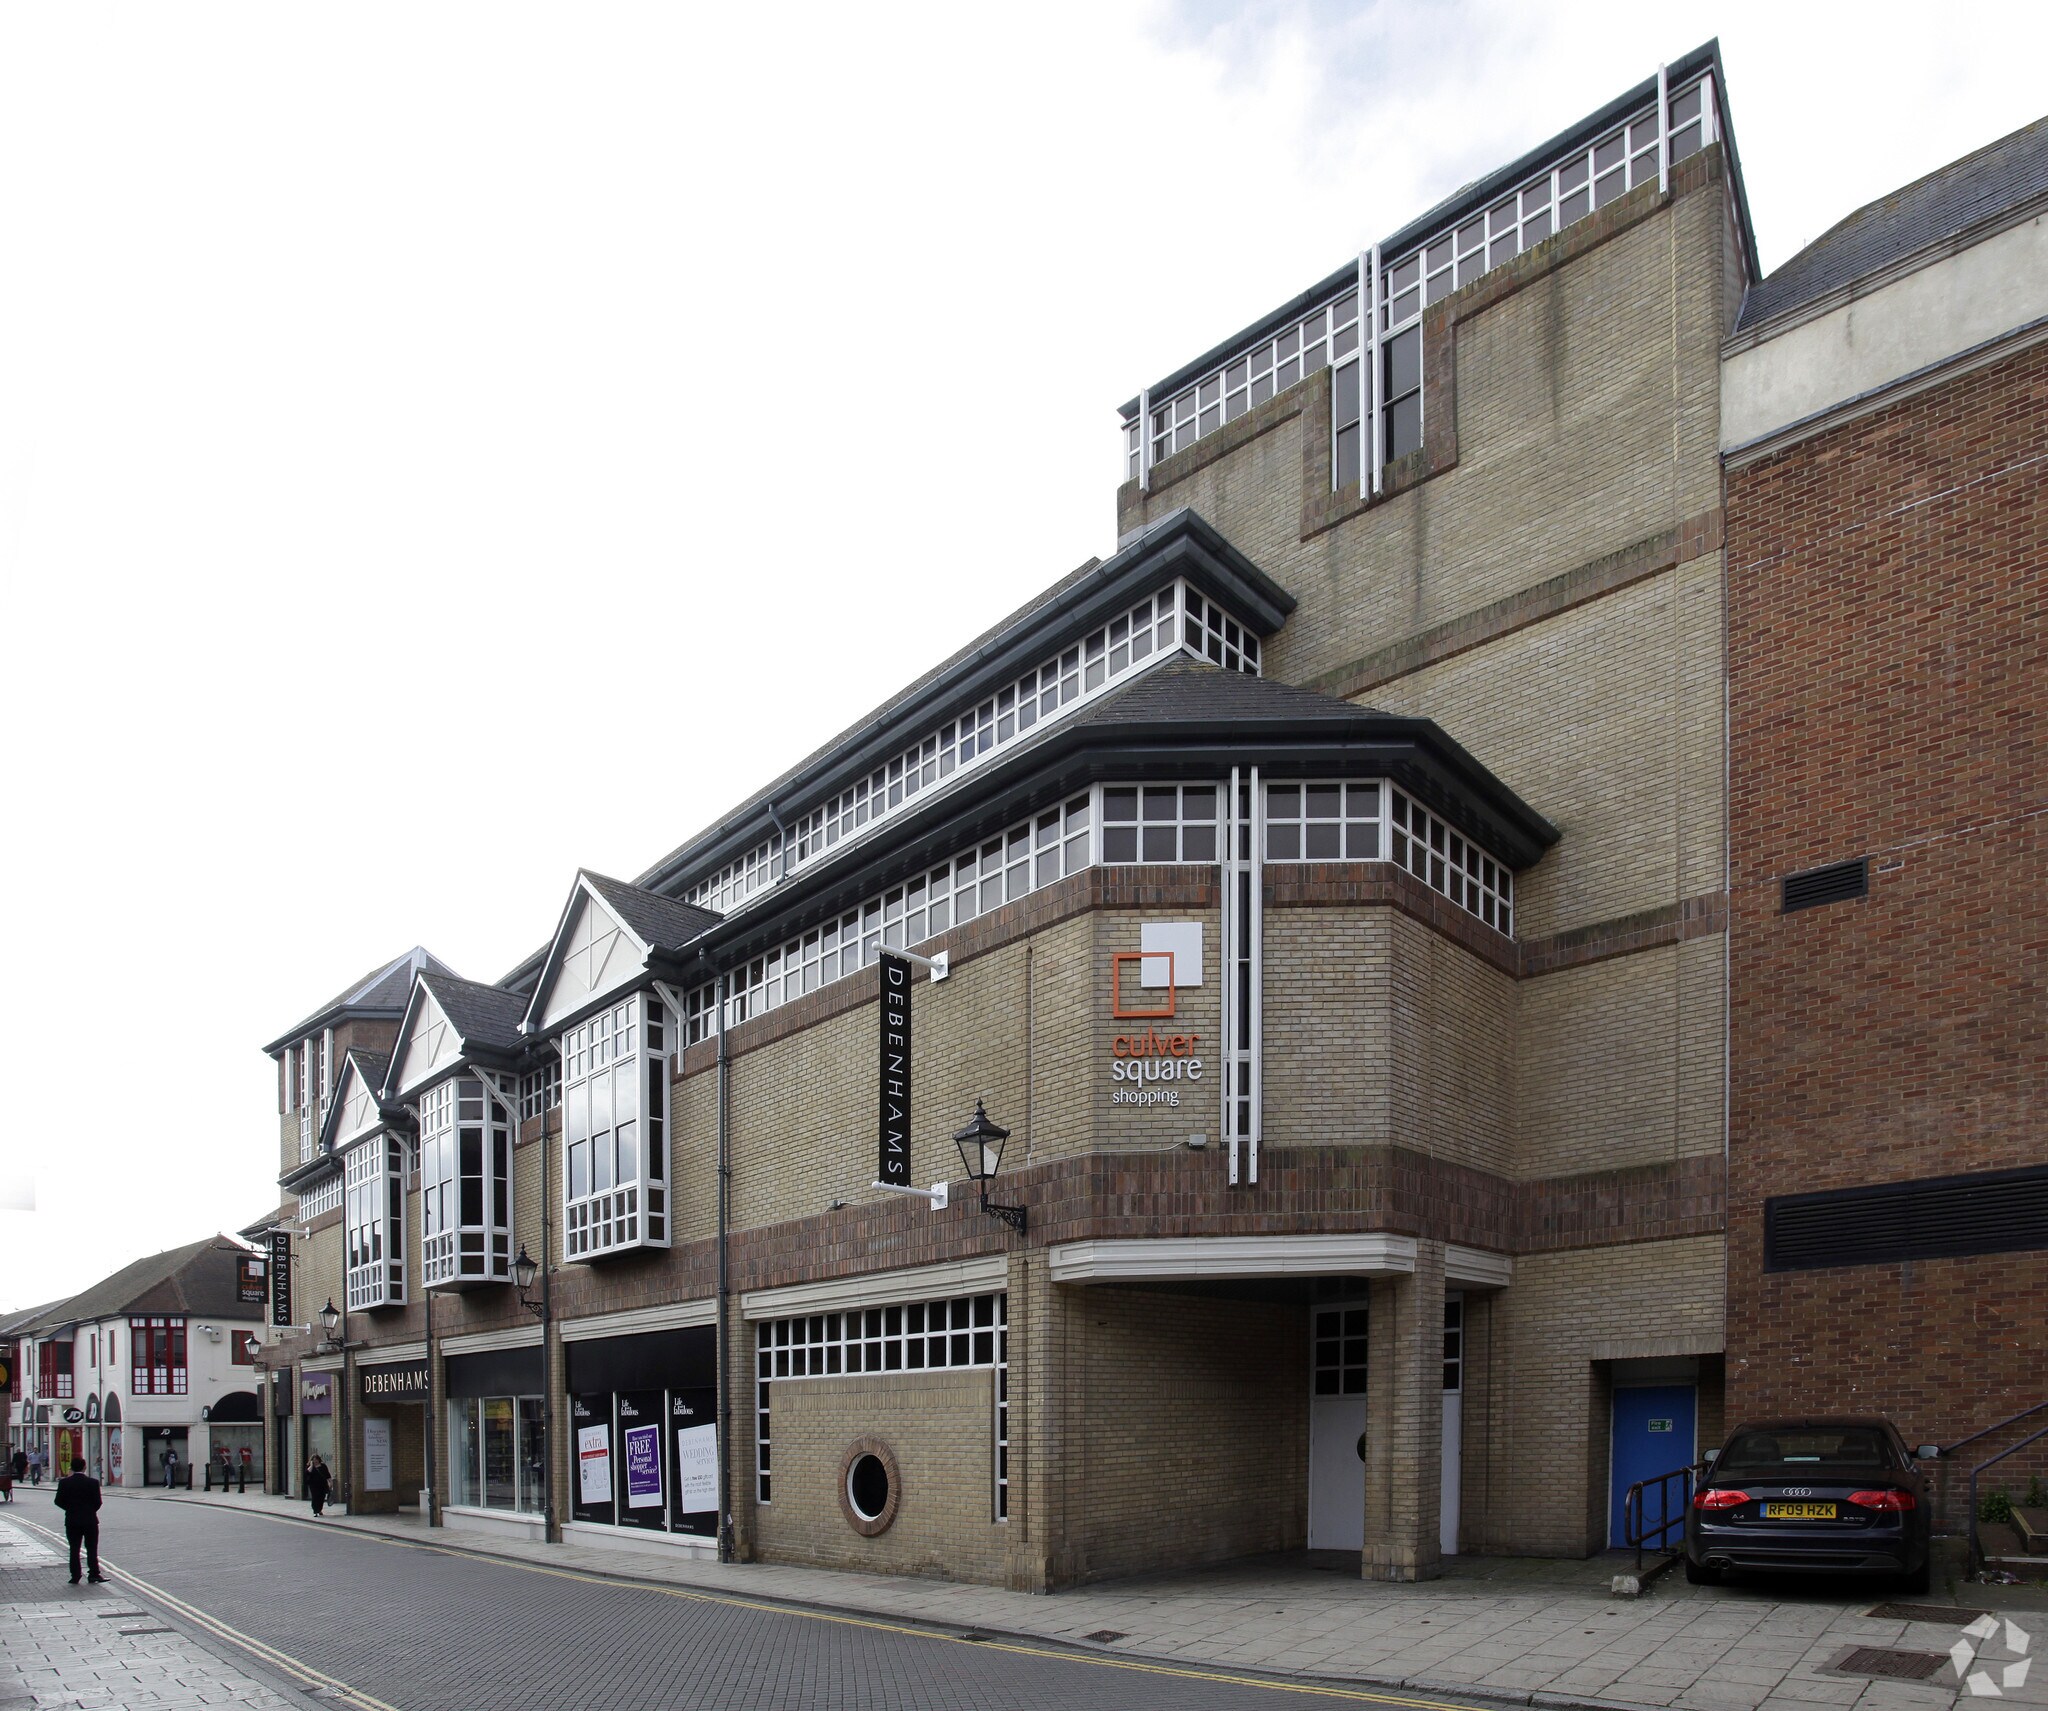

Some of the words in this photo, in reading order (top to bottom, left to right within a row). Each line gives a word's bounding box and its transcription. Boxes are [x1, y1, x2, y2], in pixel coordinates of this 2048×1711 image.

[1112, 1026, 1200, 1057] culver
[888, 966, 904, 1174] DEBENHAMS
[1112, 1059, 1203, 1089] square
[1112, 1088, 1180, 1107] shopping
[276, 1236, 287, 1322] DEBENHAMS
[241, 1289, 265, 1297] square
[365, 1369, 428, 1393] DEBENHAMS
[66, 1411, 81, 1420] JD
[160, 1428, 171, 1436] JD
[584, 1437, 602, 1449] extra
[629, 1439, 652, 1456] FREE
[633, 1453, 652, 1464] Personal
[683, 1446, 714, 1459] WEDDING
[1768, 1504, 1804, 1516] RF09
[1807, 1504, 1834, 1516] HZK
